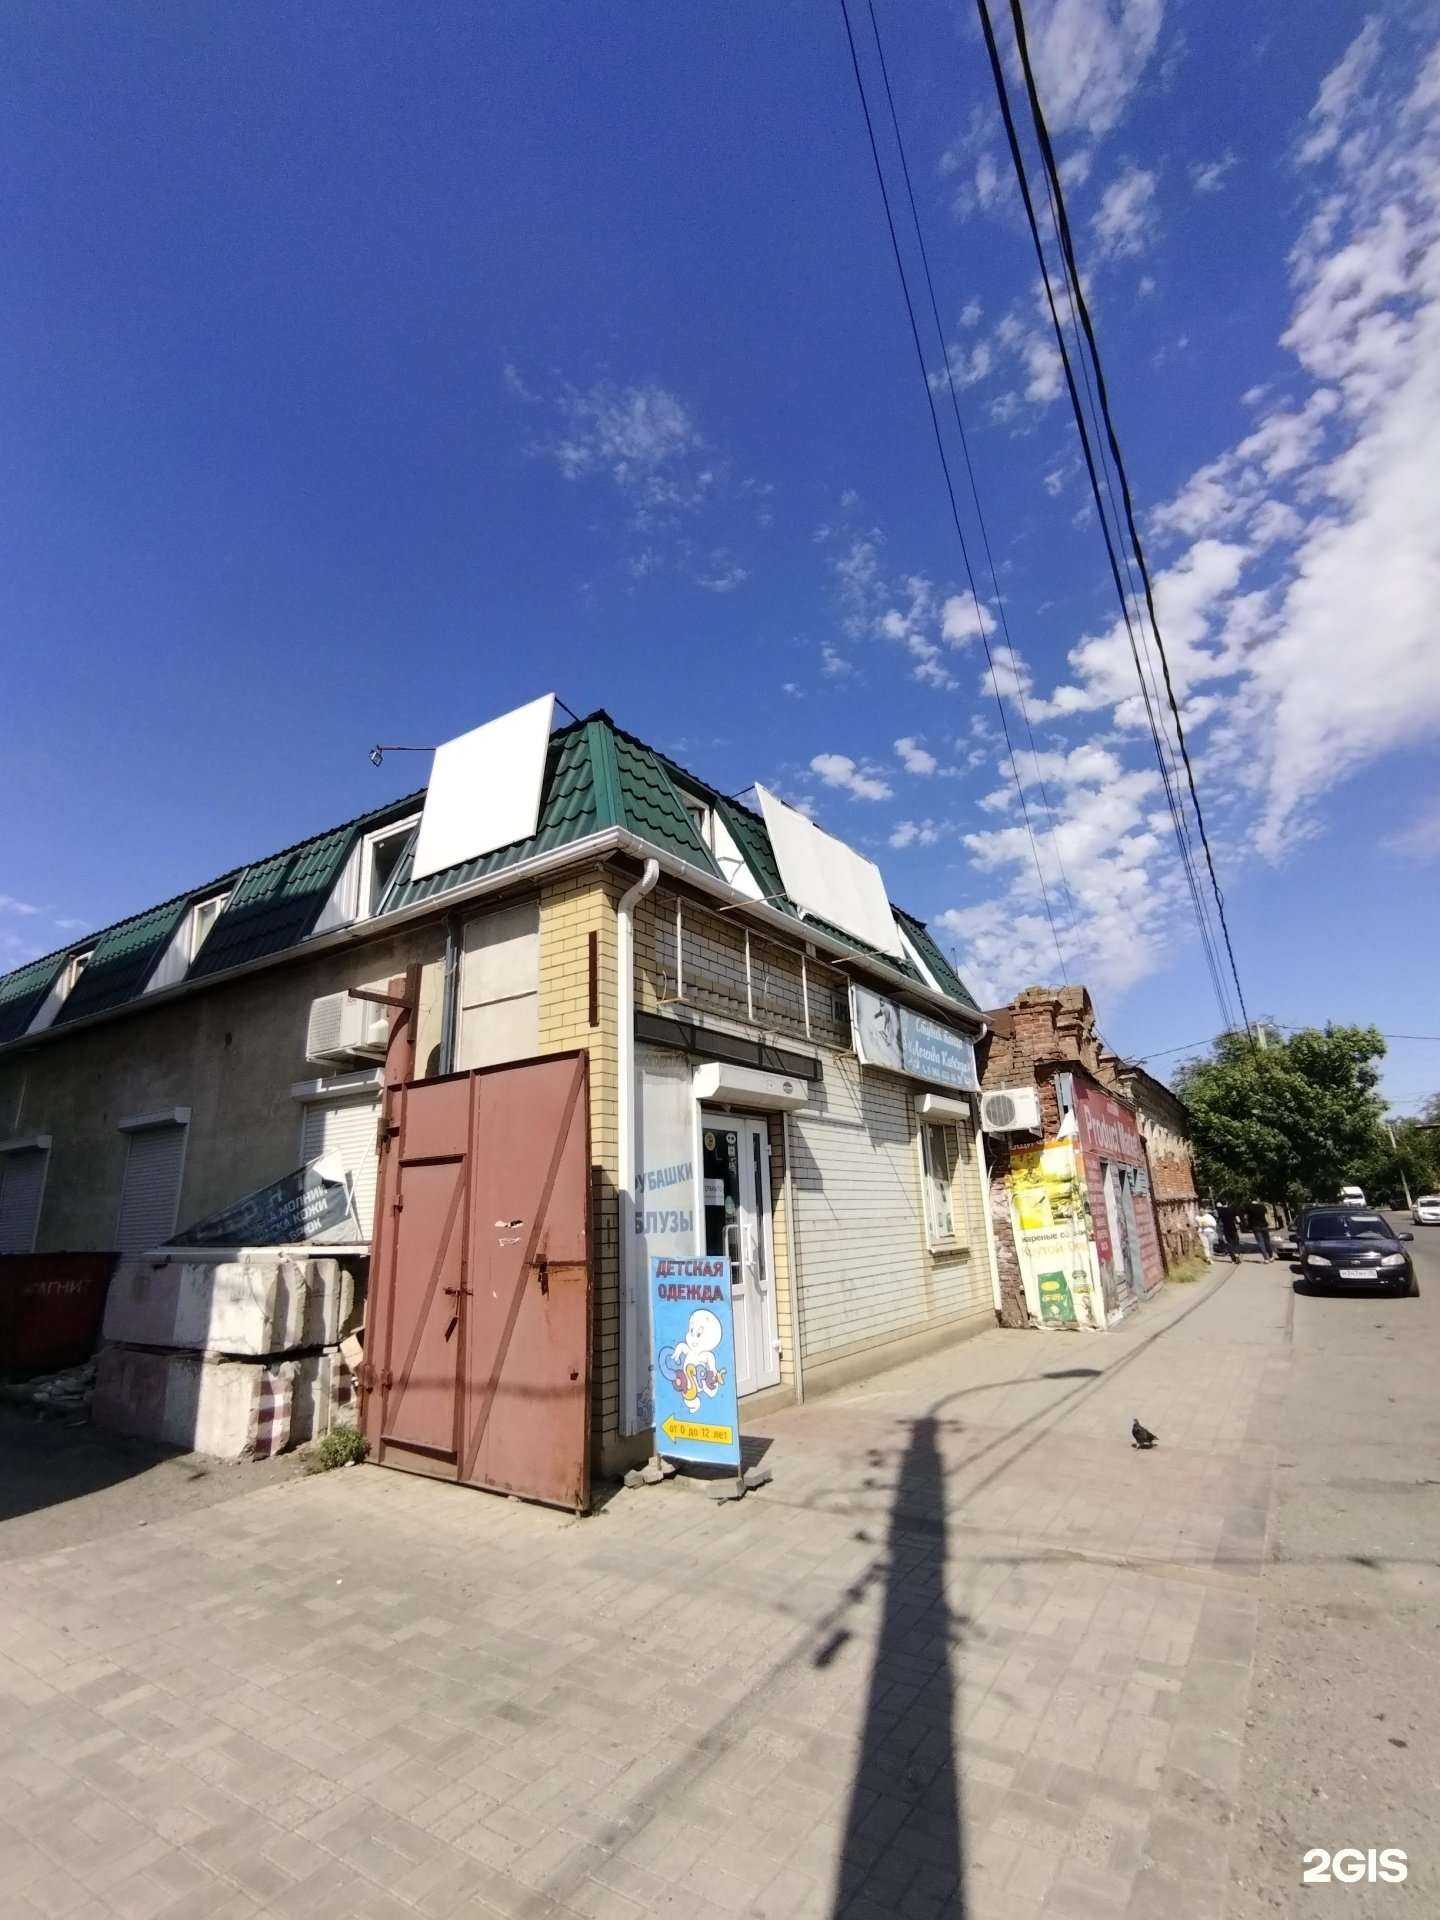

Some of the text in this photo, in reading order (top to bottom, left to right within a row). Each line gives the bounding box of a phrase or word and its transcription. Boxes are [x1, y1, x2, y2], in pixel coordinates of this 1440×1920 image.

[293, 1198, 328, 1223] КОЖИ
[634, 1210, 694, 1235] БЛУЗЫ
[656, 1260, 724, 1278] ДЕТСКАЯ
[657, 1283, 725, 1304] ОДЕЖДА
[669, 1424, 728, 1441] от 0 до 12 лет
